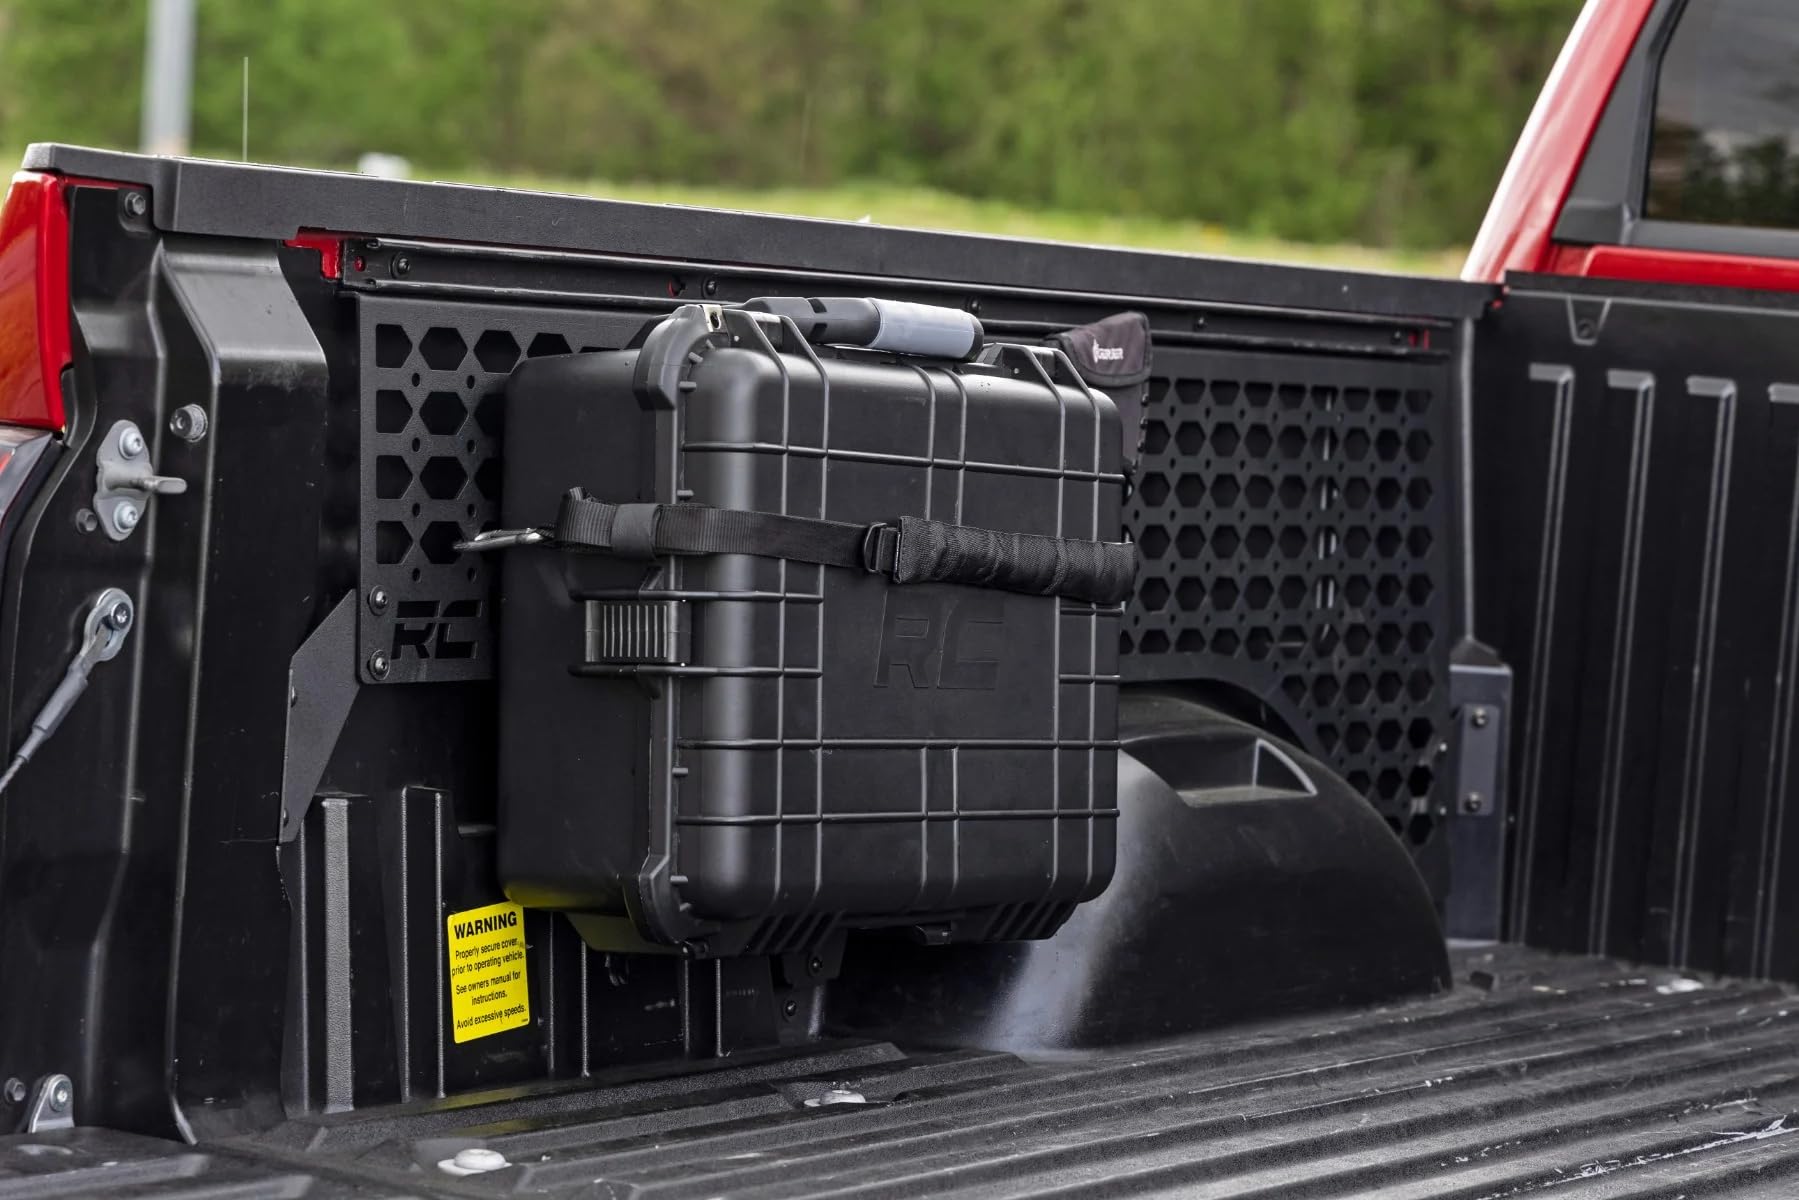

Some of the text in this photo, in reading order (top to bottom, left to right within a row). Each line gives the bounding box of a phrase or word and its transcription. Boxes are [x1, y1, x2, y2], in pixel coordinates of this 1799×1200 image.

[391, 599, 483, 660] RC
[873, 591, 1005, 691] RC
[454, 912, 516, 939] WARNING
[452, 951, 524, 978] prior to operating vehicle.
[456, 946, 479, 960] Properly
[481, 942, 500, 954] secure
[456, 971, 520, 995] See owners manual for
[472, 990, 507, 1006] instructions.
[457, 1003, 526, 1030] Avoid excessive speeds.
